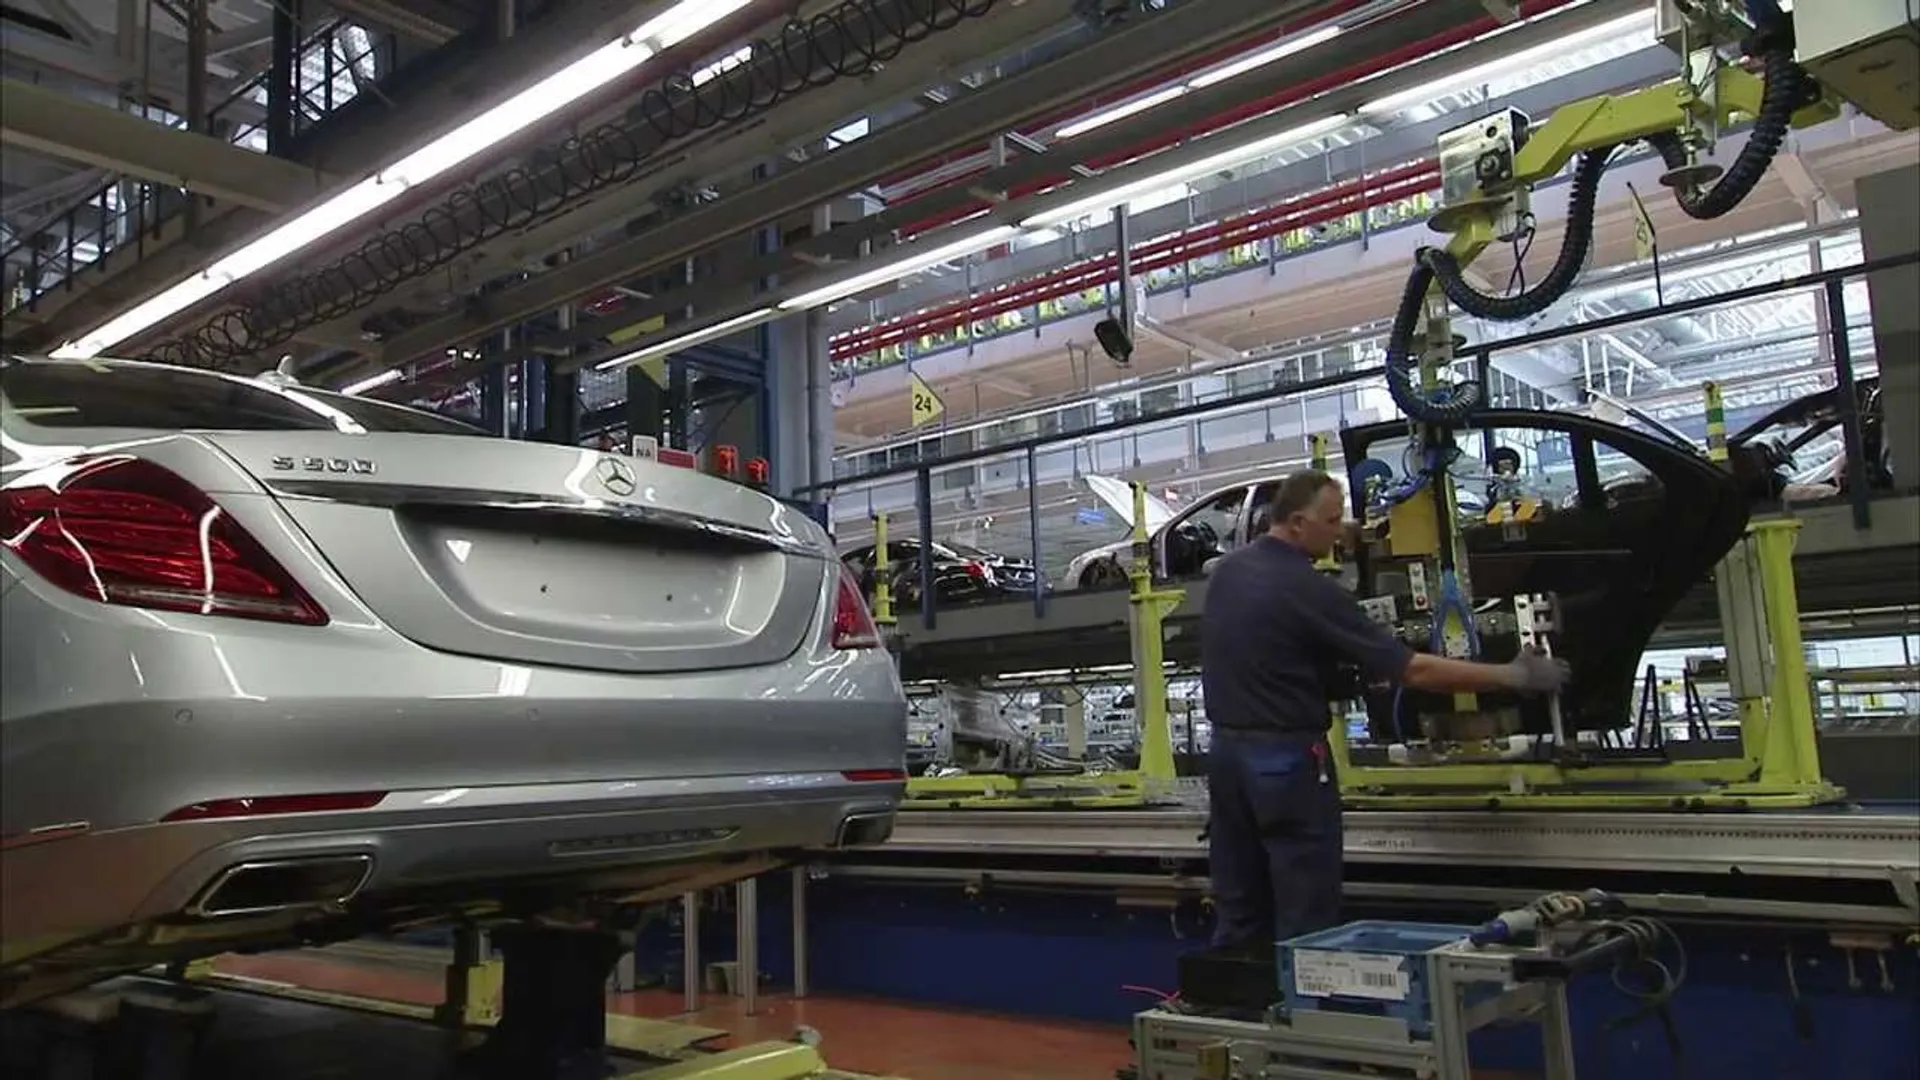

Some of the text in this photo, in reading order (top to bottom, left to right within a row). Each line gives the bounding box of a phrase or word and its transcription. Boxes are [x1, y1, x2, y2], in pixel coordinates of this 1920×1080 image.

[914, 393, 932, 413] 24
[273, 456, 376, 473] S 500
